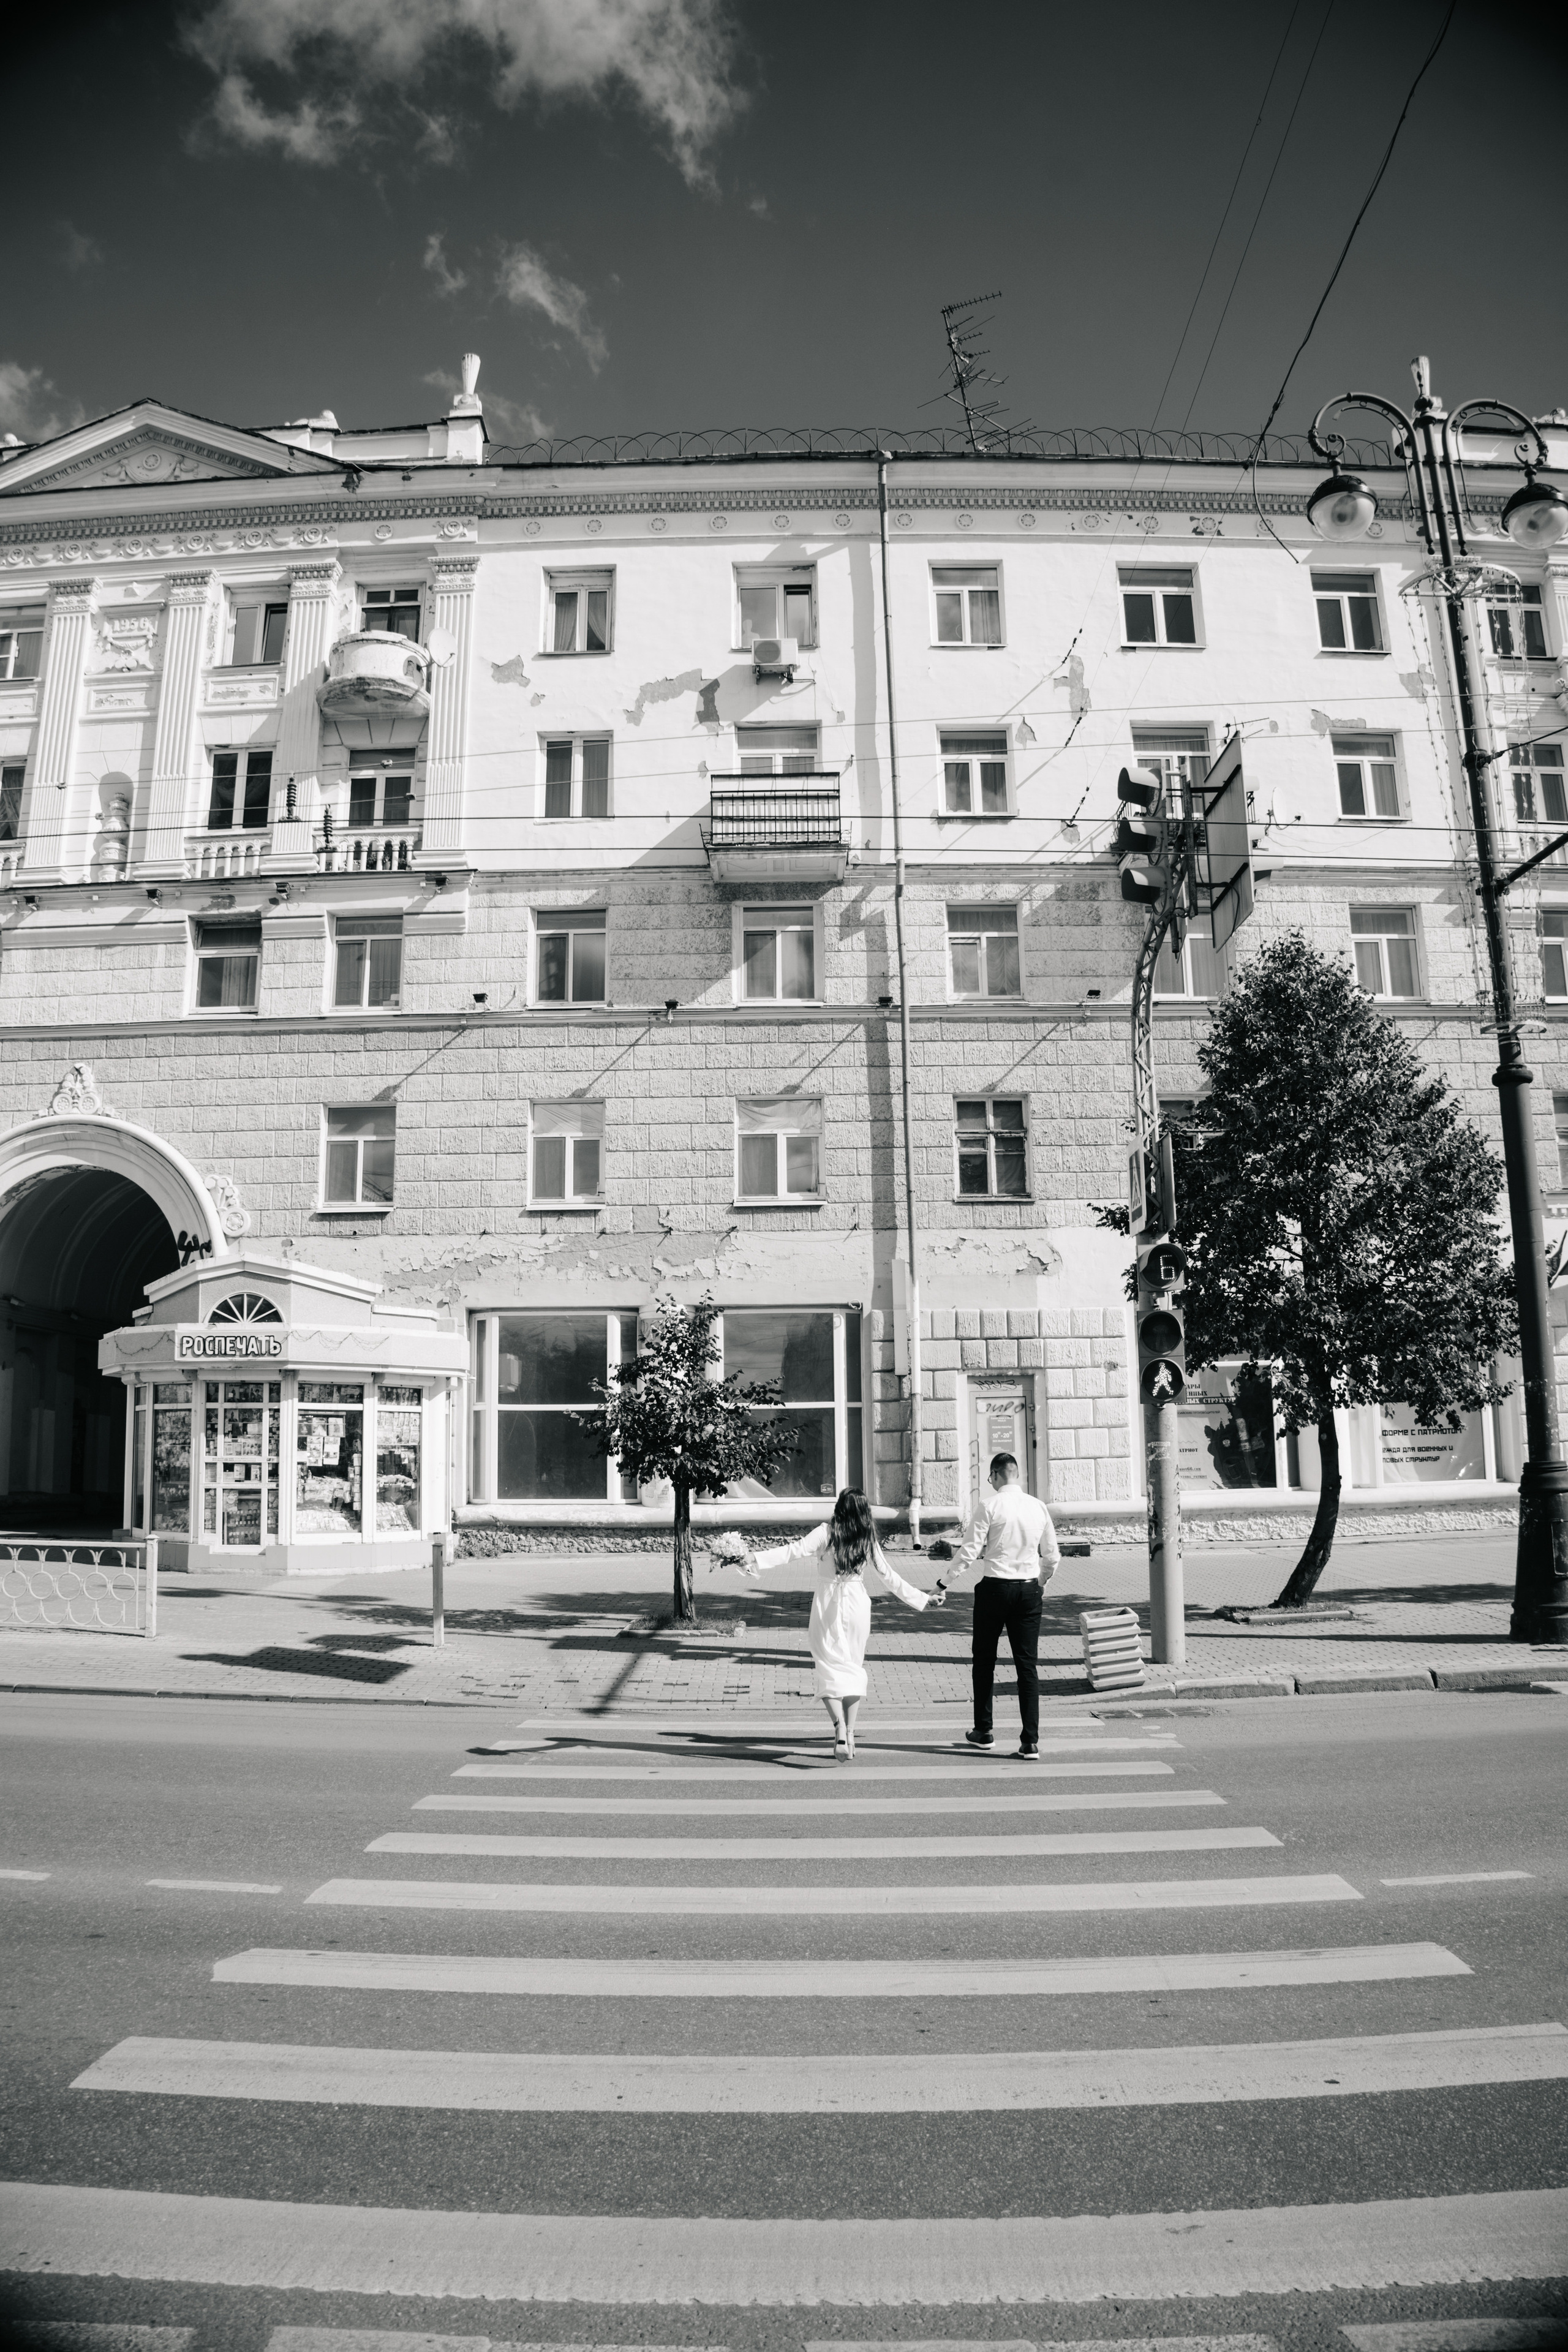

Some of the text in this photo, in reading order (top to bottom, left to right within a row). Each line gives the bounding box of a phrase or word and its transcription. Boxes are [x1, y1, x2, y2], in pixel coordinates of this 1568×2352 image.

[113, 617, 149, 632] 1956
[1159, 1254, 1175, 1280] 6
[182, 1335, 282, 1356] РОСПЕЧАТЬ
